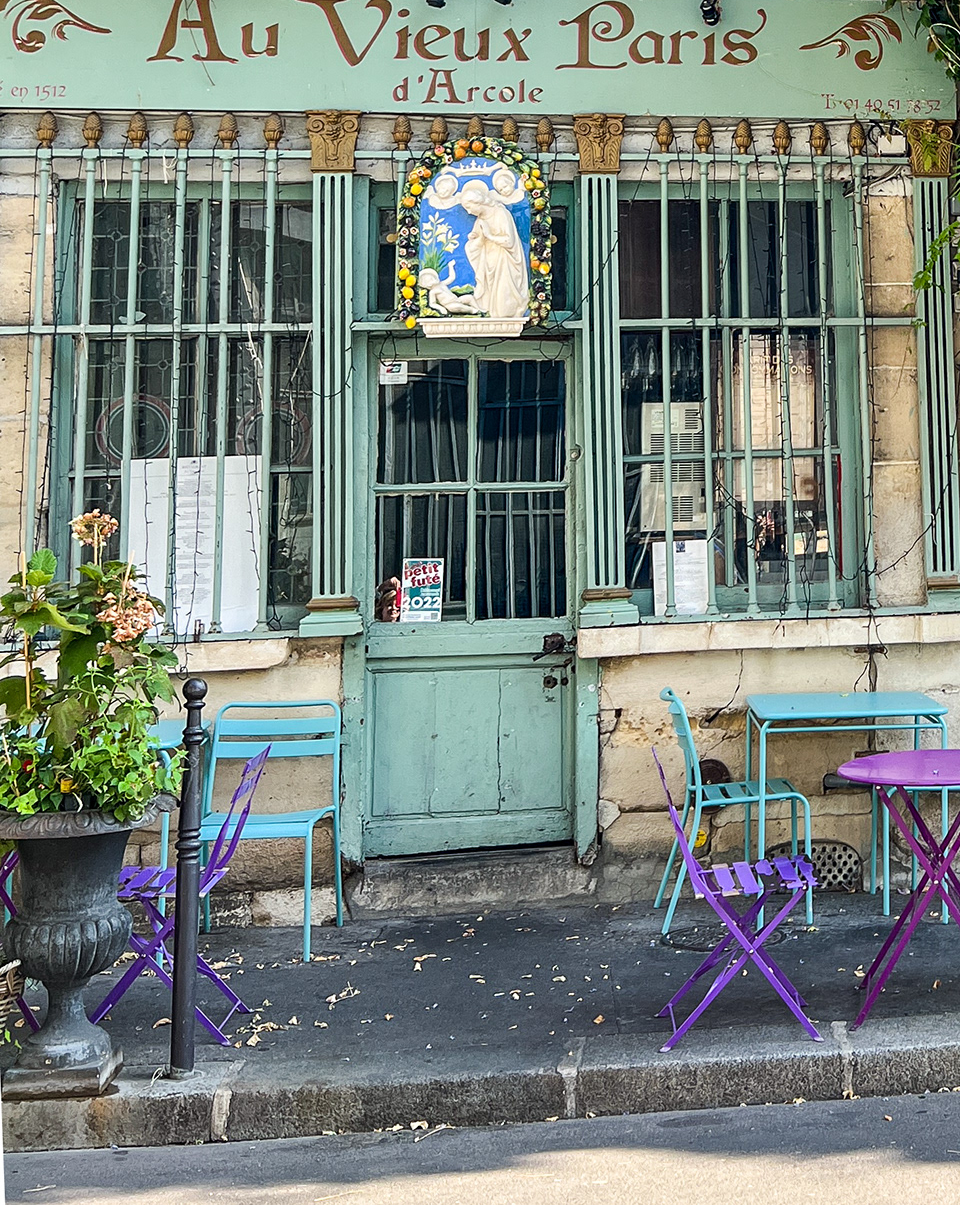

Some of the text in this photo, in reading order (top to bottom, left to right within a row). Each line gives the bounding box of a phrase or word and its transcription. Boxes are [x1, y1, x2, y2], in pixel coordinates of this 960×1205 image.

[555, 0, 767, 70] Paris
[11, 85, 67, 103] en 1512
[392, 68, 544, 104] d'Arcole
[865, 99, 882, 112] 40
[404, 563, 439, 580] petit
[411, 573, 440, 587] futé
[403, 596, 440, 609] 2022
